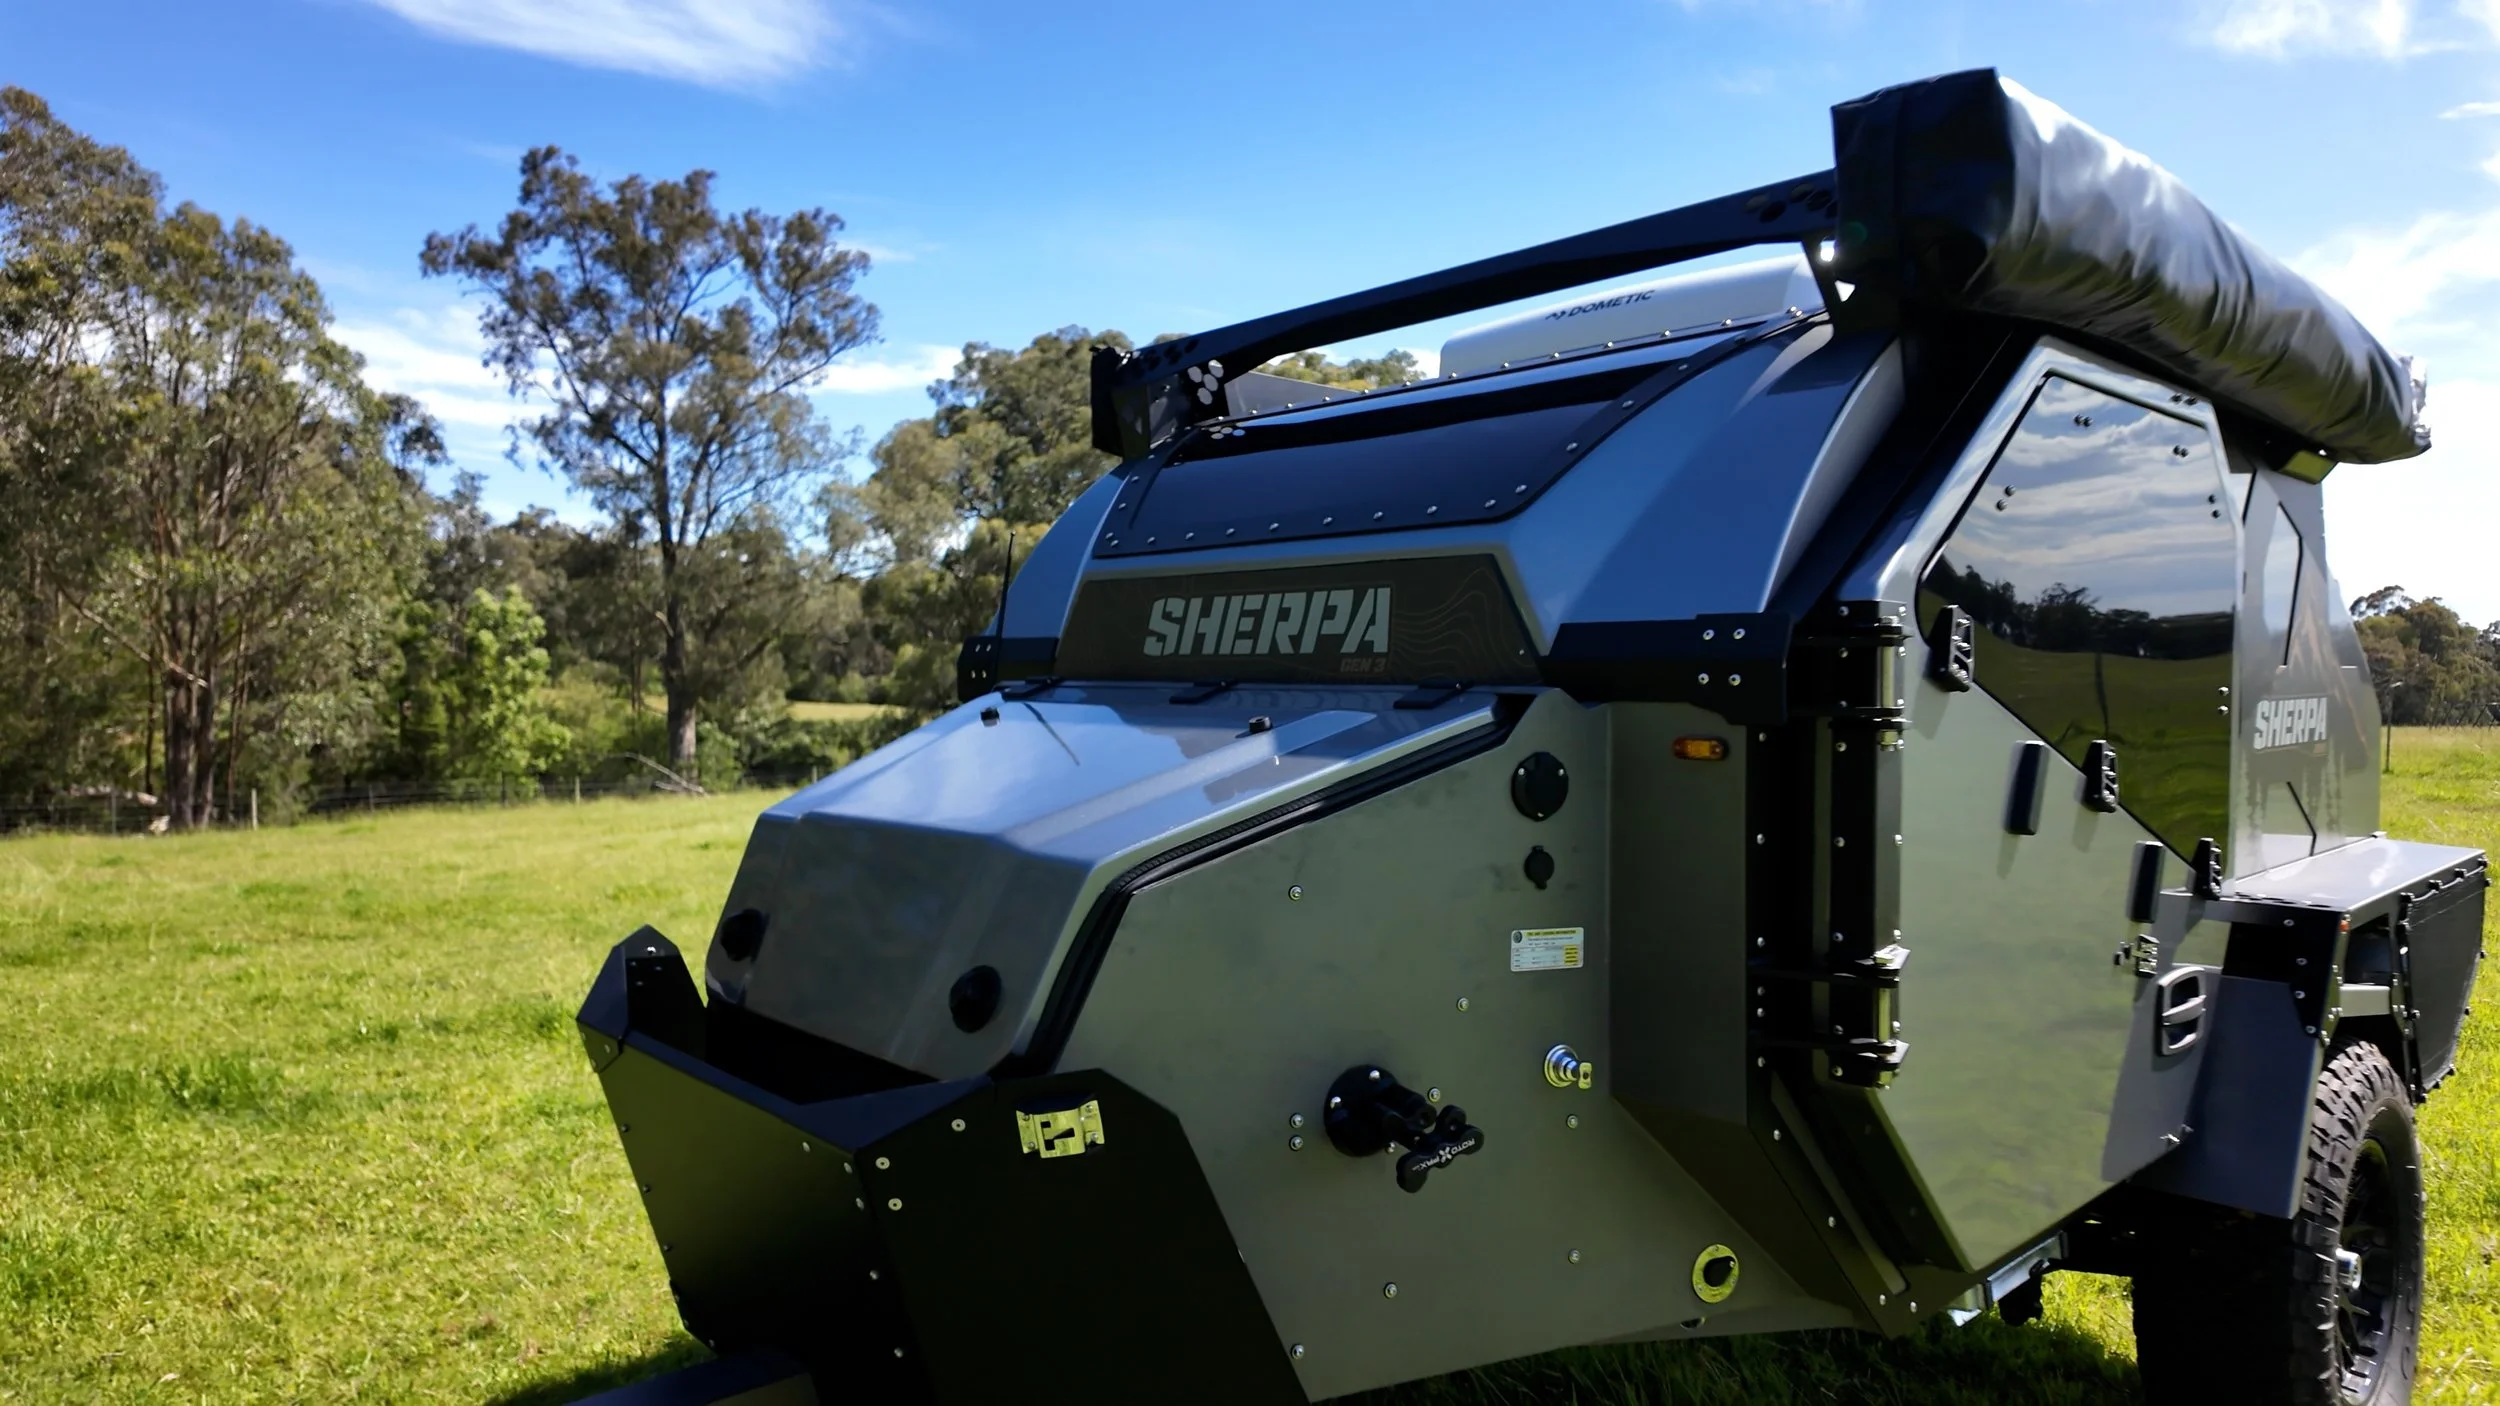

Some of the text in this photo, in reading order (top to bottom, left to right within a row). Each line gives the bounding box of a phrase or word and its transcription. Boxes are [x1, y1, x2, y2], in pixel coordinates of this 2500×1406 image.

[1568, 290, 1655, 317] DOMETIC
[1143, 587, 1391, 657] SHERPA
[1340, 657, 1387, 673] GEN 3
[2253, 697, 2328, 750] SHERPA
[1450, 1138, 1475, 1155] ROTO
